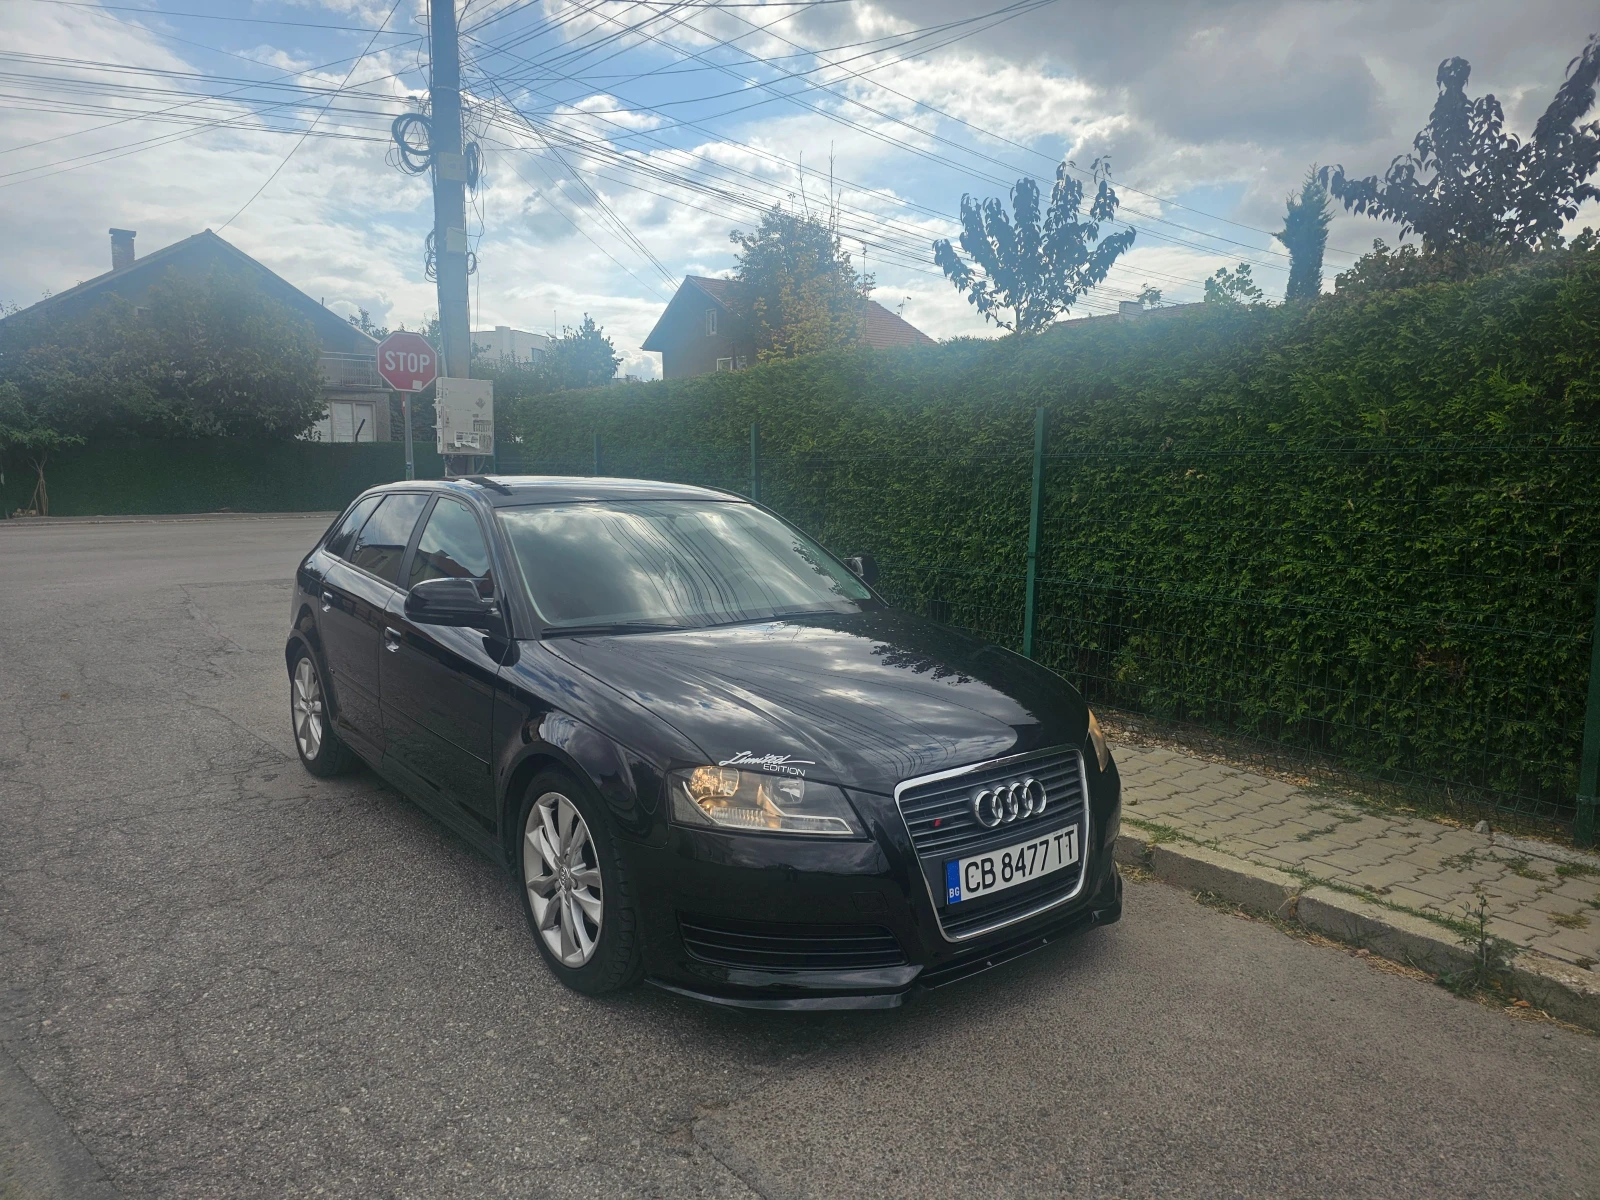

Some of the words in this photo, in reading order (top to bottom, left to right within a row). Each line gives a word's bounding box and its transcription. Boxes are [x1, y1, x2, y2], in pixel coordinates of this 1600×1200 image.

[385, 351, 430, 373] STOP
[719, 750, 815, 767] Limited
[763, 763, 806, 776] EDITION
[965, 857, 996, 893] CB
[1001, 840, 1049, 883] 8477
[1053, 830, 1075, 864] TT
[949, 887, 960, 898] BG
